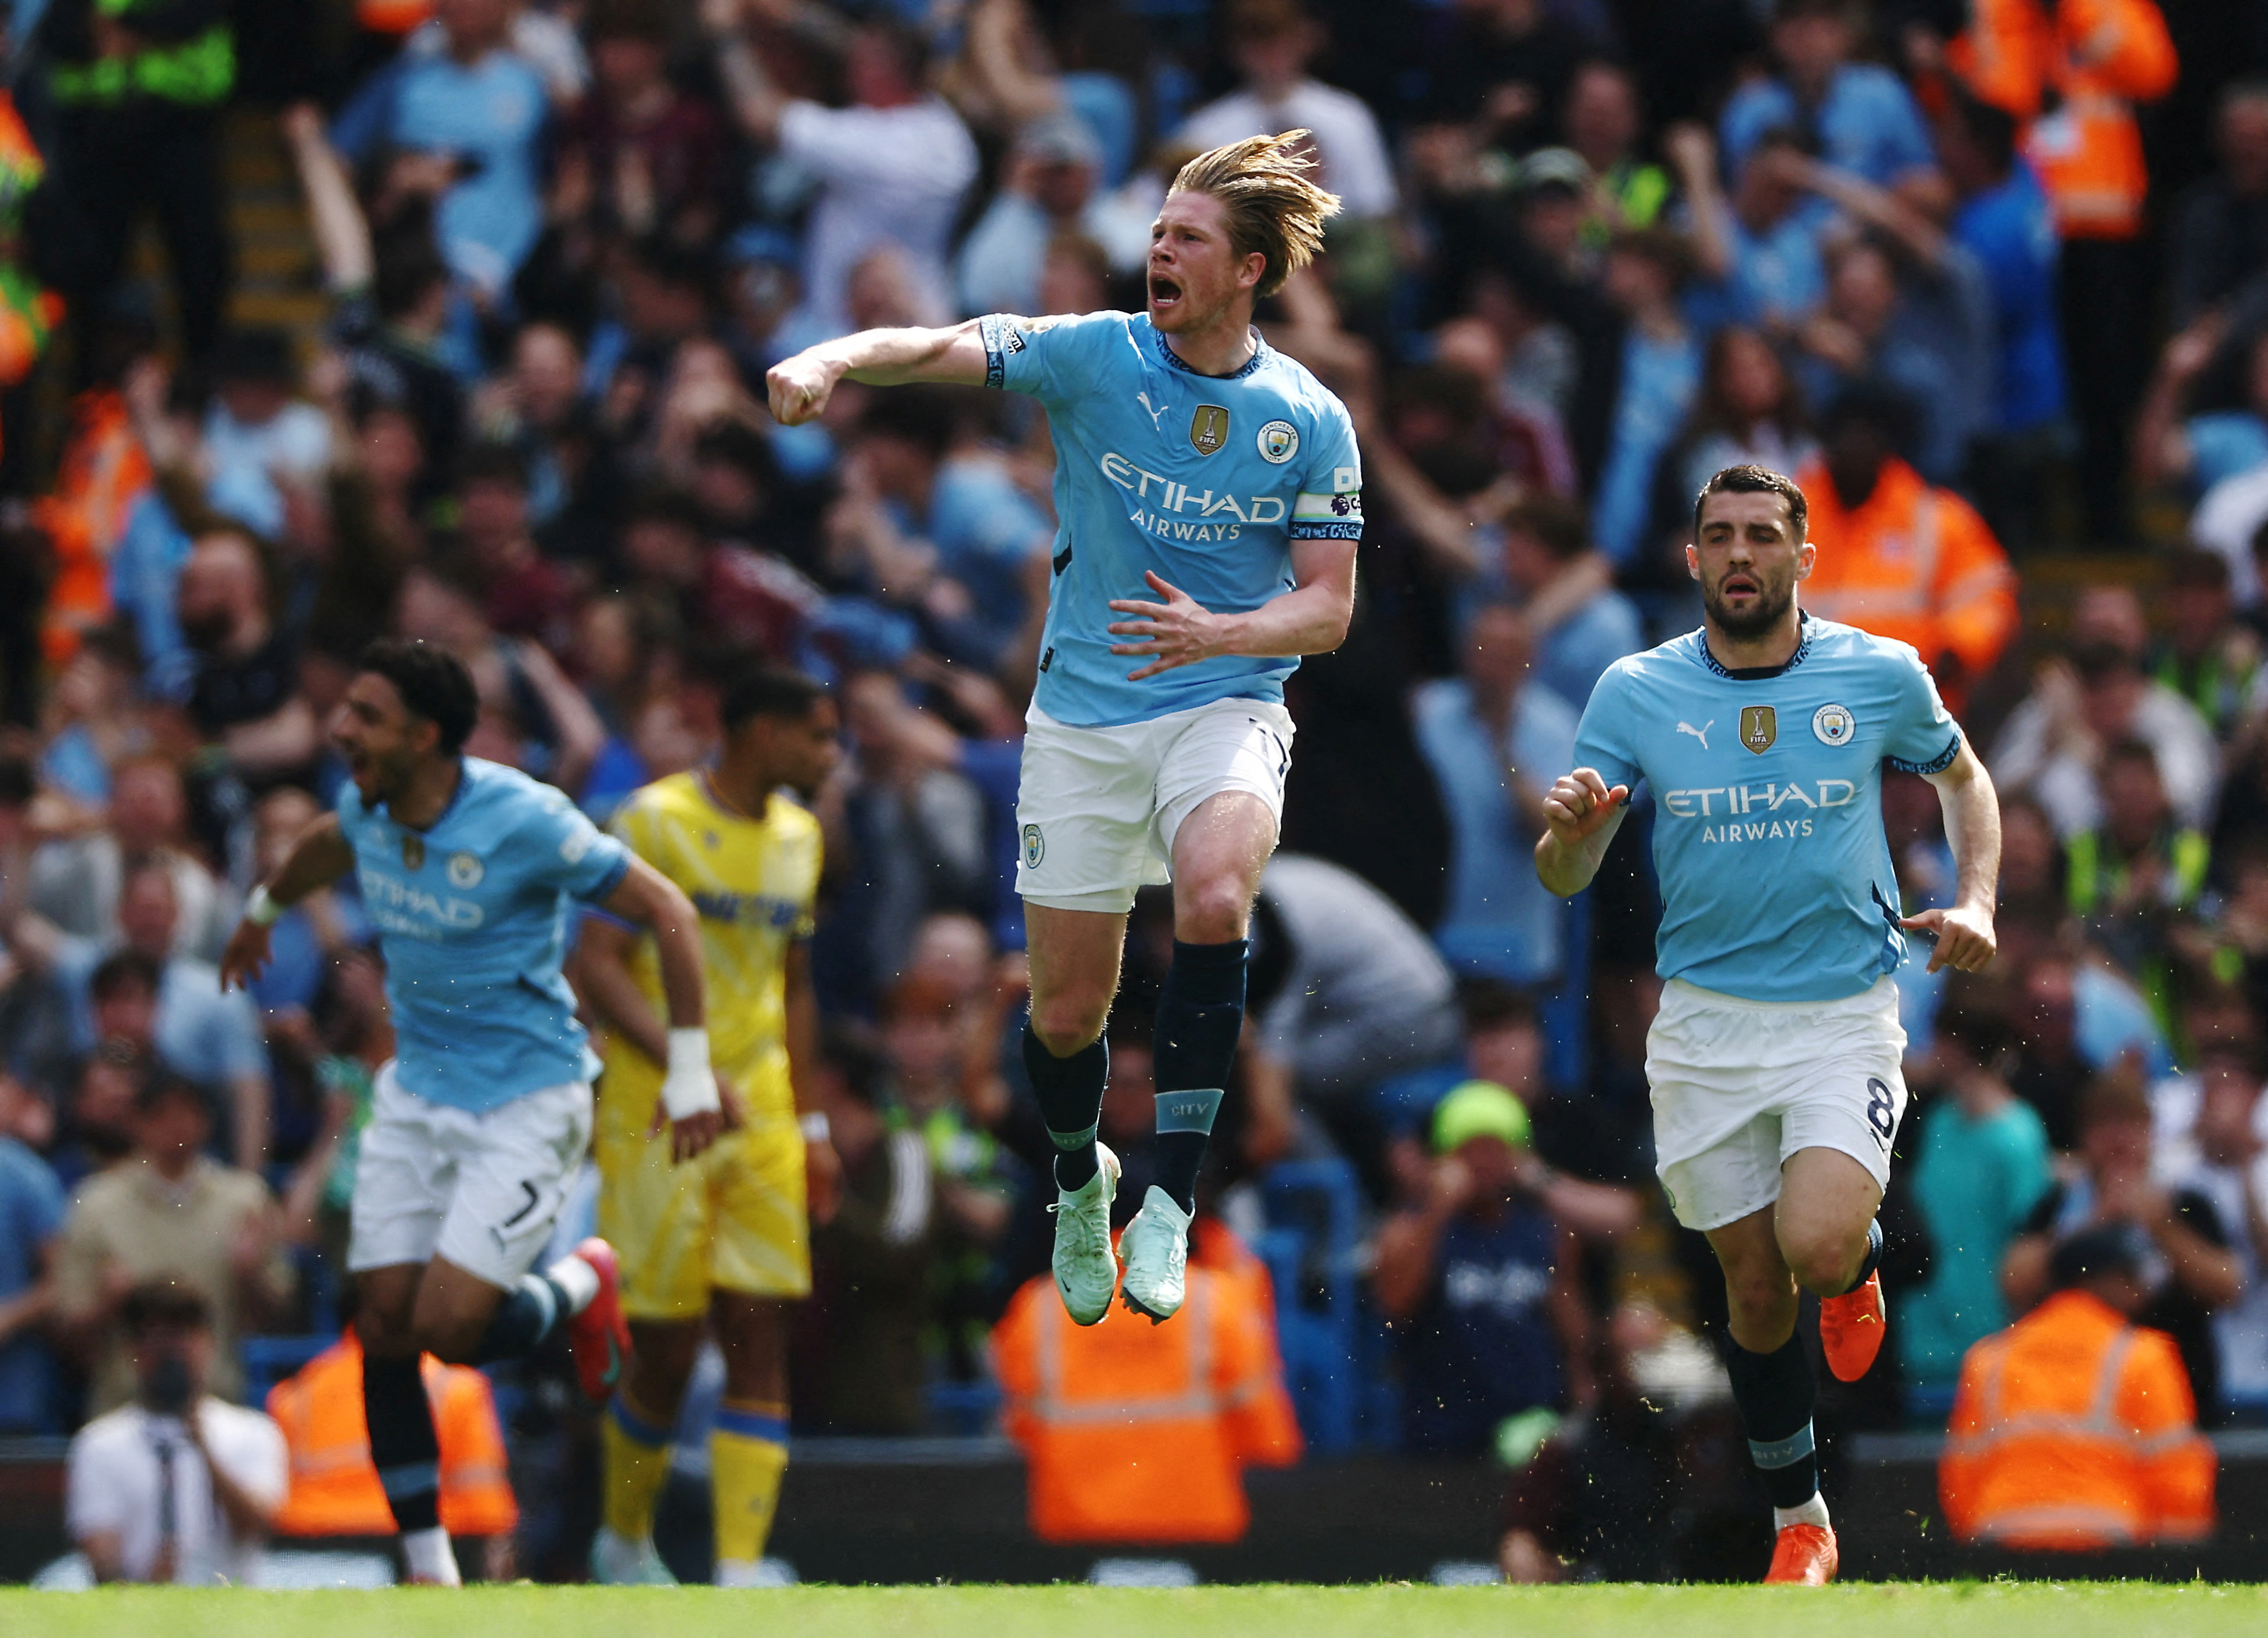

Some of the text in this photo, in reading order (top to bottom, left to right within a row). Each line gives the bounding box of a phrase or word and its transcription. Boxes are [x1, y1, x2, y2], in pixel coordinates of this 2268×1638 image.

[1199, 436, 1216, 444] FIFA
[1101, 452, 1285, 523] ETIHAD
[1130, 508, 1241, 541] AIRWAYS
[1665, 779, 1855, 817] ETIHAD
[1702, 819, 1813, 843] AIRWAYS
[1172, 1103, 1209, 1115] CITY
[1867, 1077, 1895, 1138] 8
[504, 1179, 538, 1228] 7
